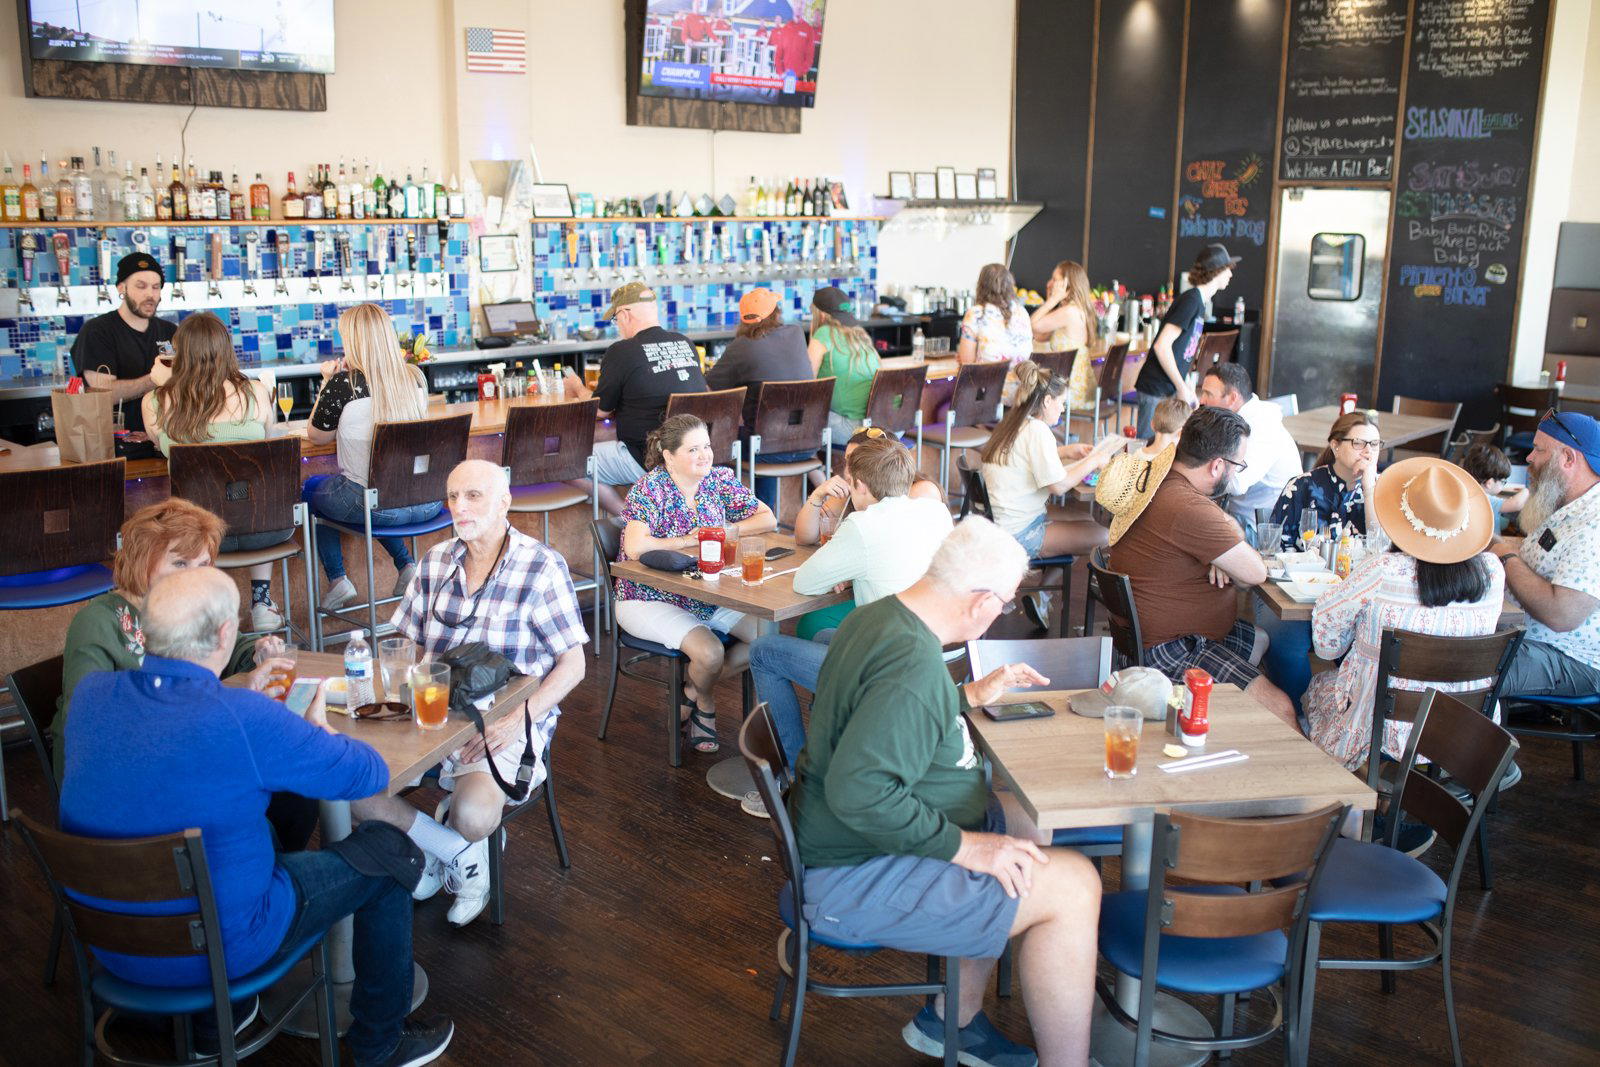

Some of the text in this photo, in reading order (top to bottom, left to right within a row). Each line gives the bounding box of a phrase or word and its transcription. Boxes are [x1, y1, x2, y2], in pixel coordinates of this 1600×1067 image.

[1405, 106, 1491, 139] SEASONAL
[1304, 160, 1327, 177] Have
[1329, 159, 1338, 177] A
[1409, 220, 1445, 244] Baby
[1478, 222, 1510, 243] Ribs
[1465, 236, 1505, 252] Back
[1434, 247, 1480, 269] Baby
[465, 863, 479, 879] N
